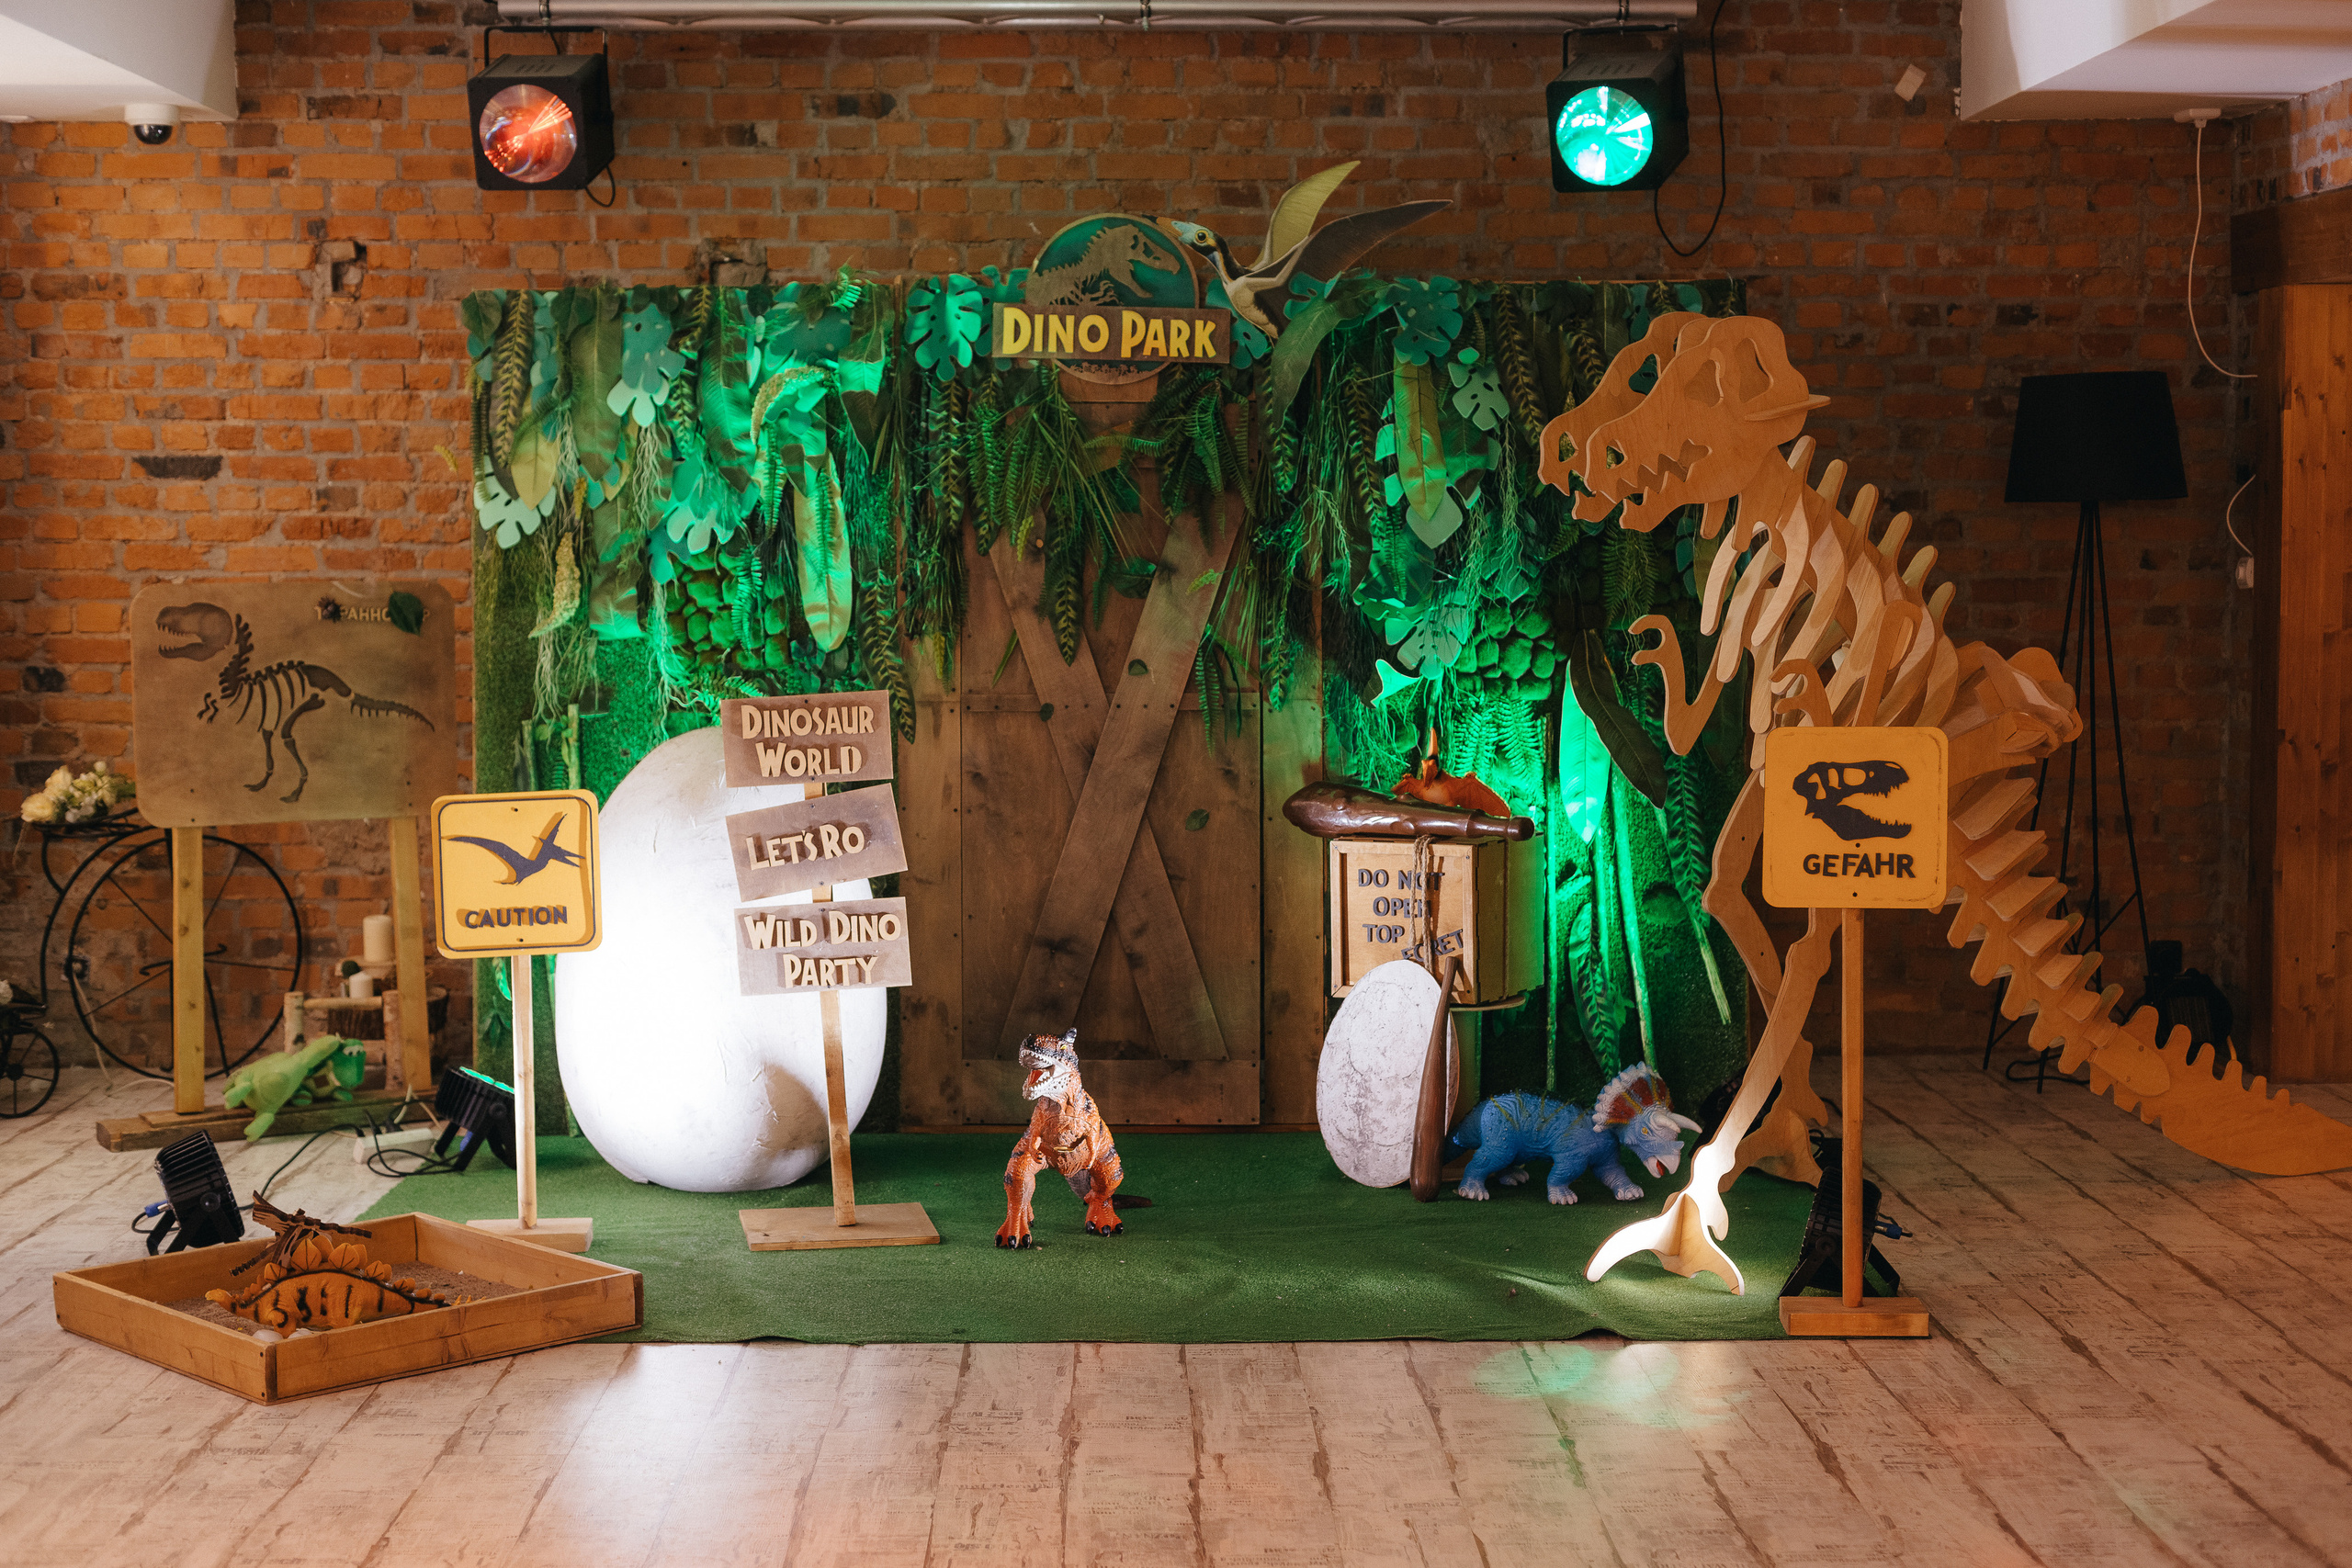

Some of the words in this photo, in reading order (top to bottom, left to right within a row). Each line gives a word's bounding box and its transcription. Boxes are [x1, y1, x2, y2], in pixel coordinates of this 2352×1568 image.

[1002, 307, 1110, 355] DINO
[1121, 310, 1217, 358] PARK
[741, 705, 875, 739] DINOSAUR
[755, 741, 863, 778] WORLD
[746, 829, 819, 871] LET'S
[820, 824, 865, 860] RO
[1358, 868, 1389, 888] DO
[1803, 852, 1917, 879] GEFAHR
[464, 906, 568, 930] CAUTION
[744, 914, 818, 950] WILD
[829, 910, 901, 945] DINO
[1363, 923, 1406, 944] TOP
[1401, 929, 1464, 963] ECRET
[783, 953, 878, 988] PARTY
